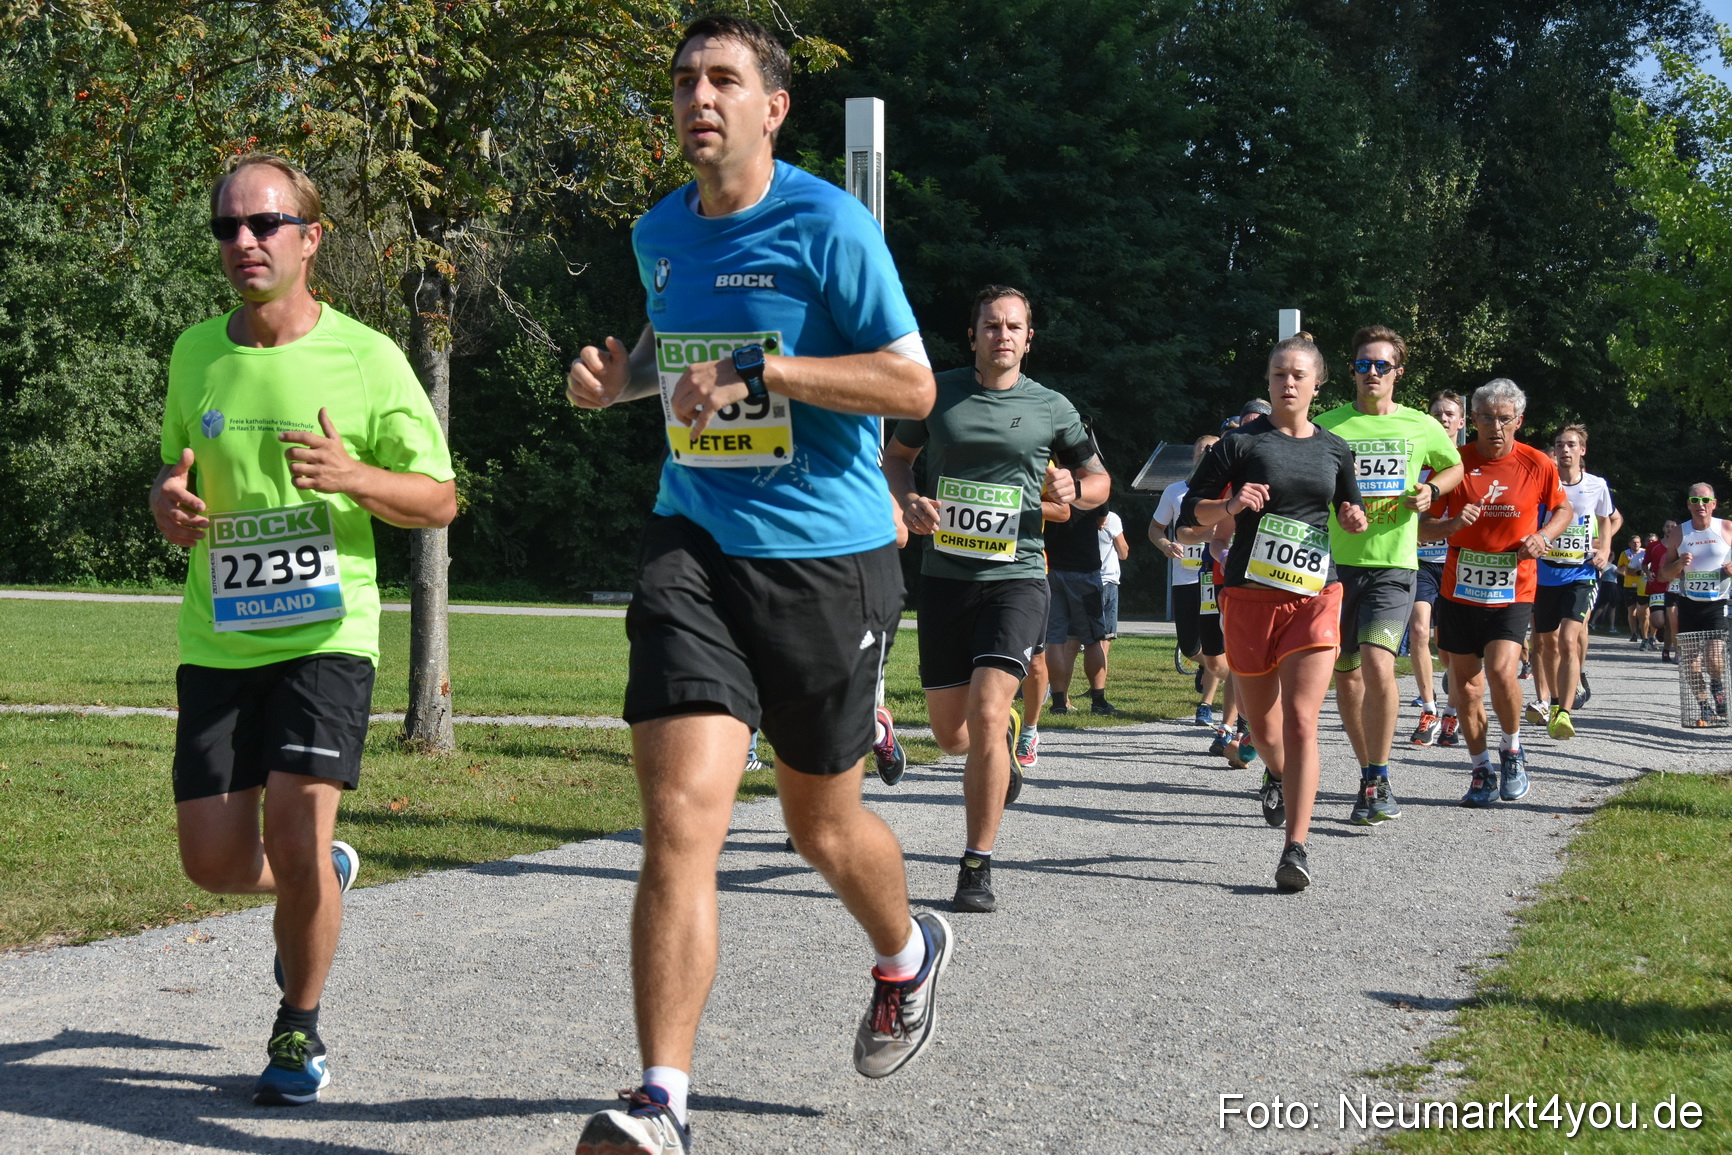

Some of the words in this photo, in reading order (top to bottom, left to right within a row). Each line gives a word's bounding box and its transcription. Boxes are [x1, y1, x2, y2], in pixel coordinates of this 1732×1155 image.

[715, 274, 775, 288] BOCK
[662, 342, 752, 364] BOC
[245, 418, 279, 426] katholische
[280, 420, 315, 429] Volksschule
[690, 434, 753, 451] PETER
[944, 482, 1014, 506] BOCK
[215, 507, 320, 544] BOCK
[946, 506, 1009, 534] 1067
[1366, 513, 1397, 525] SEN
[1266, 518, 1323, 548] BOCK
[941, 534, 1007, 551] CHRISTIAN
[1265, 540, 1322, 573] 1068
[1463, 551, 1511, 567] BOCK
[221, 545, 322, 590] 2239
[1688, 572, 1715, 580] BOCK
[1269, 569, 1304, 586] JULIA
[1463, 567, 1510, 587] 2133
[1464, 588, 1505, 598] MICHAEL
[1689, 582, 1716, 591] 2721
[235, 593, 316, 617] ROLAND
